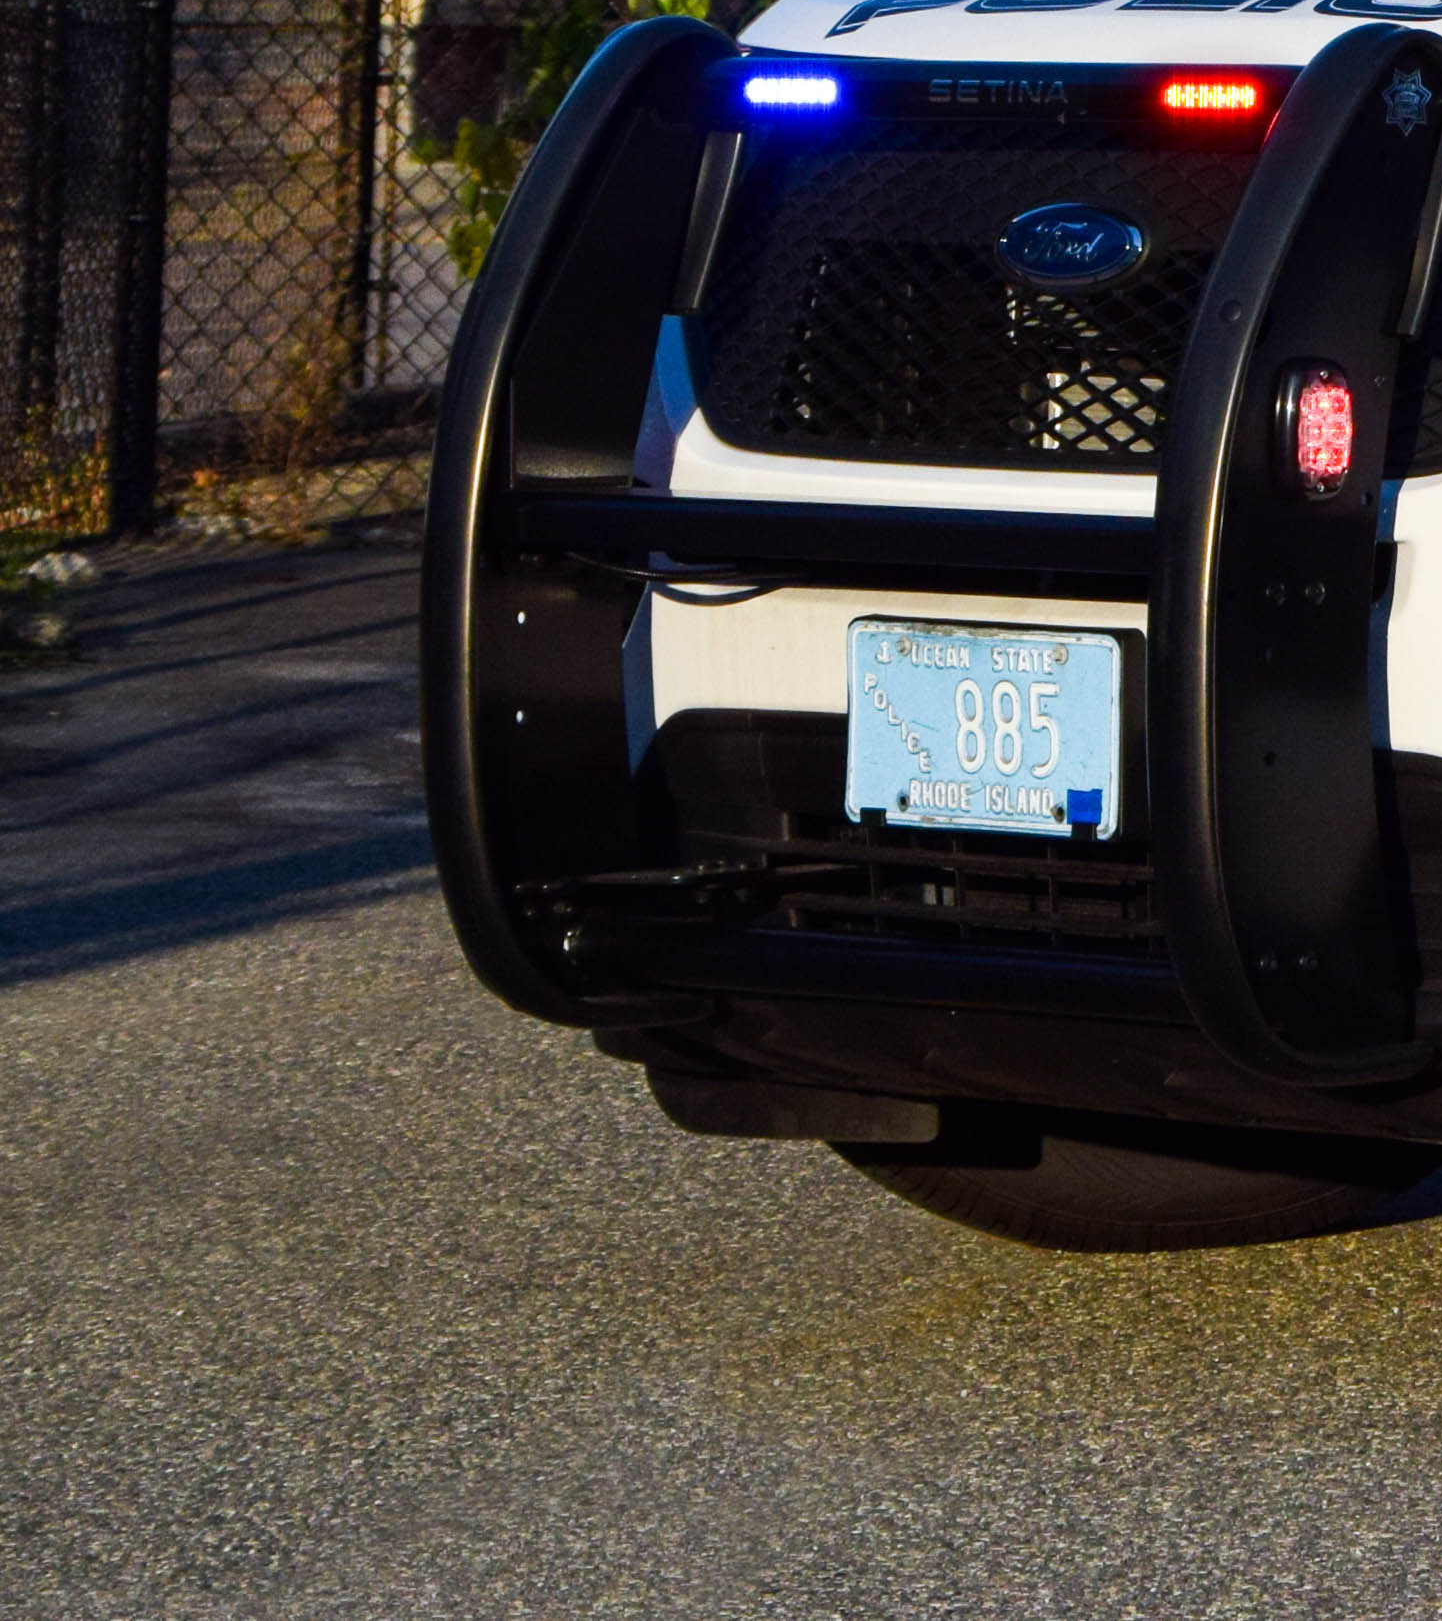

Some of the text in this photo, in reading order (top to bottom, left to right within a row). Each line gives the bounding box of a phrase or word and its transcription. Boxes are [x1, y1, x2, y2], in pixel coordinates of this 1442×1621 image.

[928, 79, 1069, 104] SETINA
[910, 641, 1054, 675] OCEAN STATE
[863, 672, 932, 774] POLICE
[954, 677, 1062, 780] 885
[908, 779, 1054, 818] RHODE ISLAND
